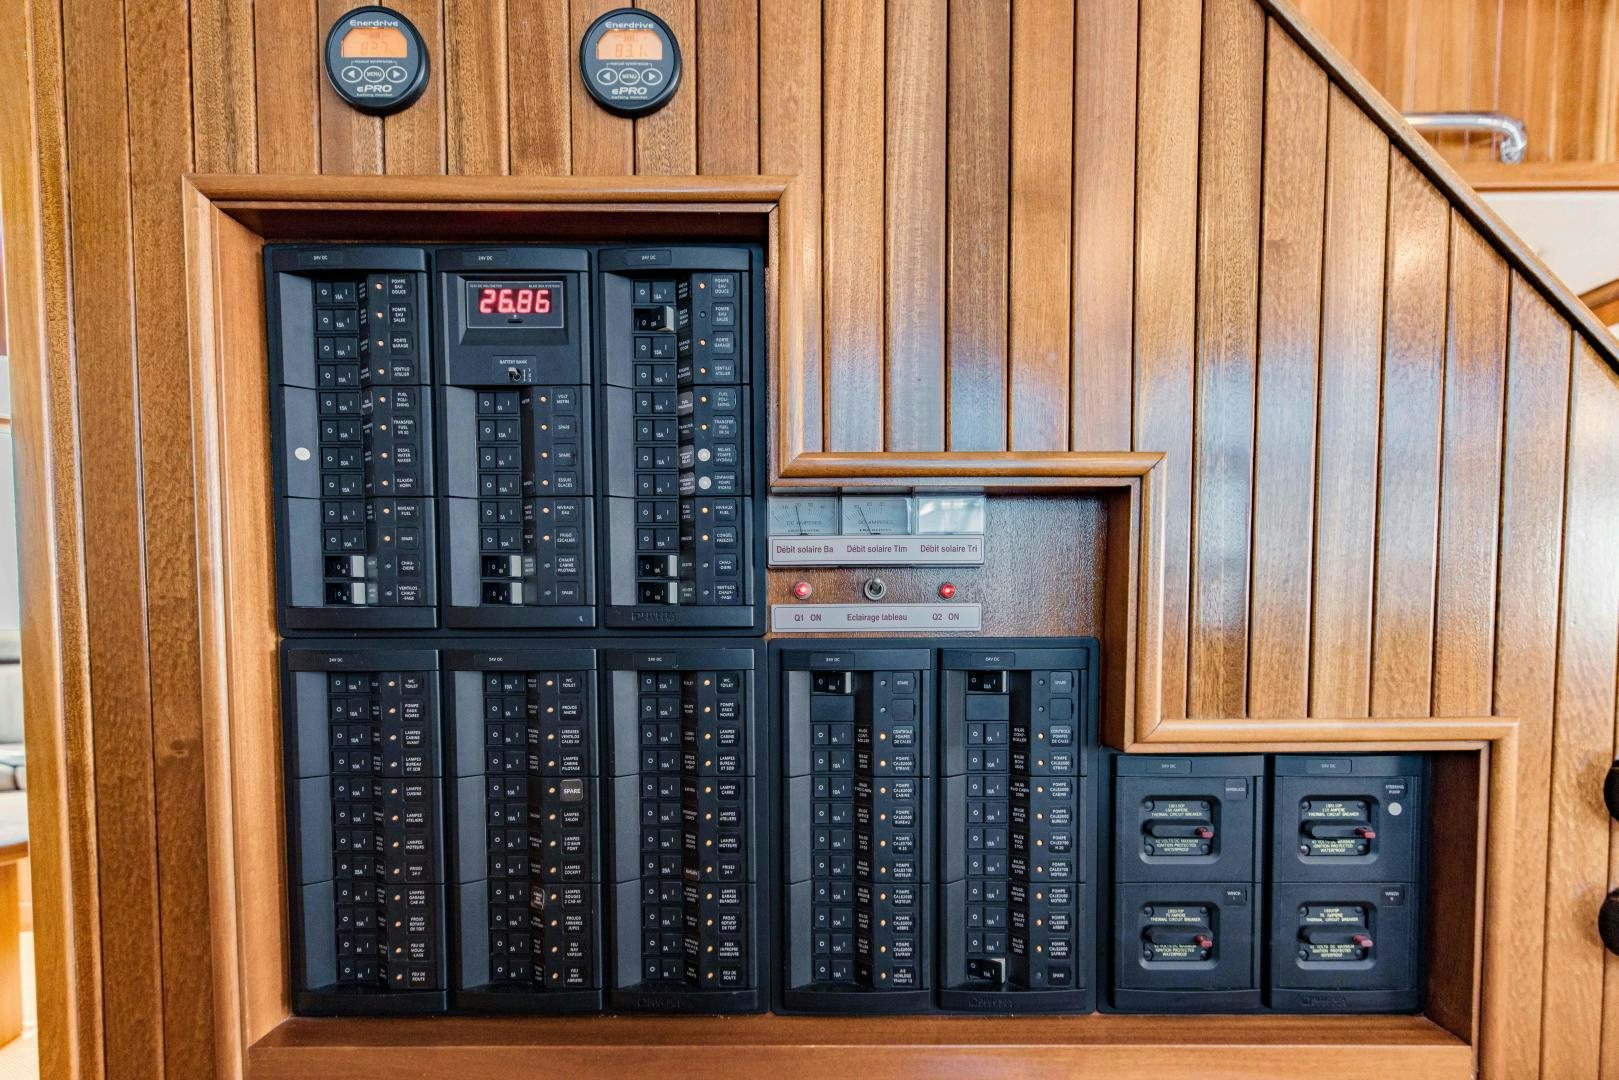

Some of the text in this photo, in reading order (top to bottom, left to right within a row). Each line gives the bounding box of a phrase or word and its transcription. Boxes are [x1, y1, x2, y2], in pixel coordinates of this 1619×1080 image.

[356, 84, 393, 93] ePRO
[611, 87, 648, 95] ePRO
[480, 289, 550, 313] 26.86
[776, 545, 796, 554] Débit
[797, 545, 822, 554] solaire
[846, 545, 866, 553] Débit
[867, 545, 892, 553] solaire
[920, 544, 978, 553] Débit solaire Tri
[794, 614, 822, 622] Q1 ON
[847, 613, 908, 623] Eclairage tableau
[932, 613, 959, 621] Q2 ON
